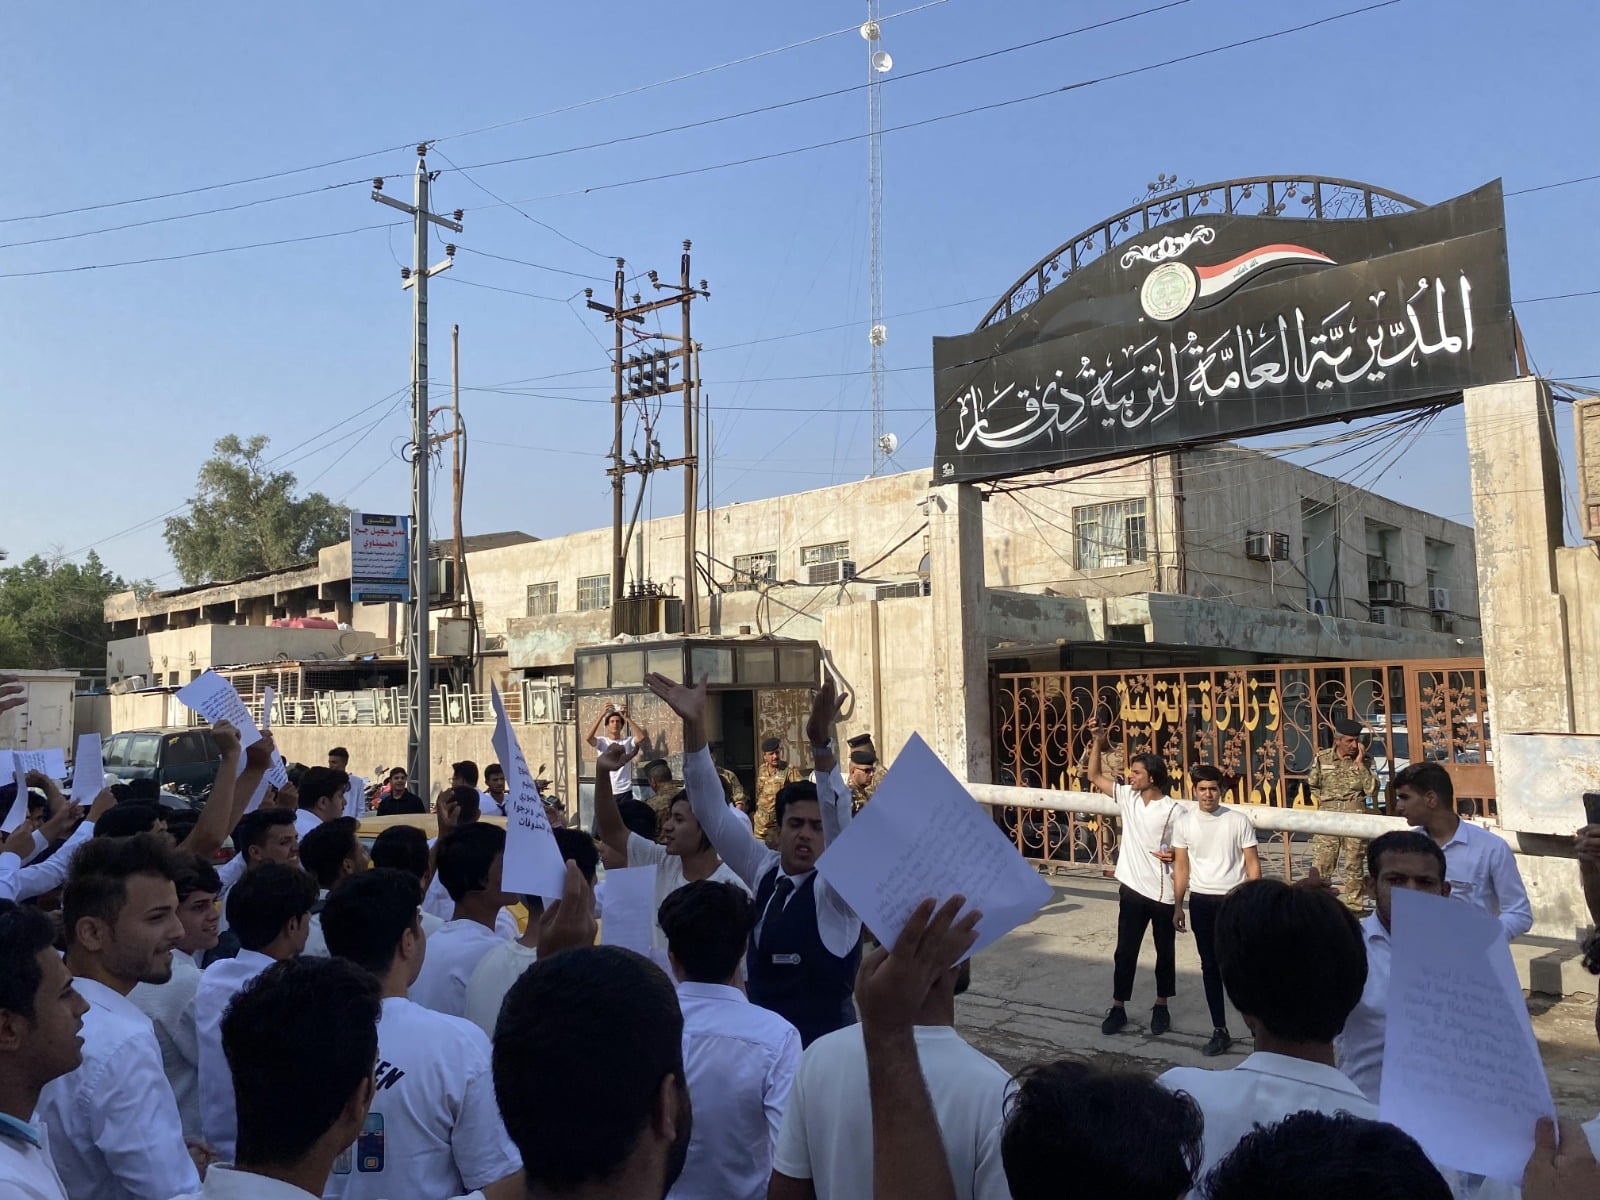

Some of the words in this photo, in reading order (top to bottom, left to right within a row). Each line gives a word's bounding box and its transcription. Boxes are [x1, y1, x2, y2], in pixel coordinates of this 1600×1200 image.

[1116, 680, 1188, 737] التربية
[1199, 678, 1280, 732] وزارة
[375, 1059, 405, 1091] EN
